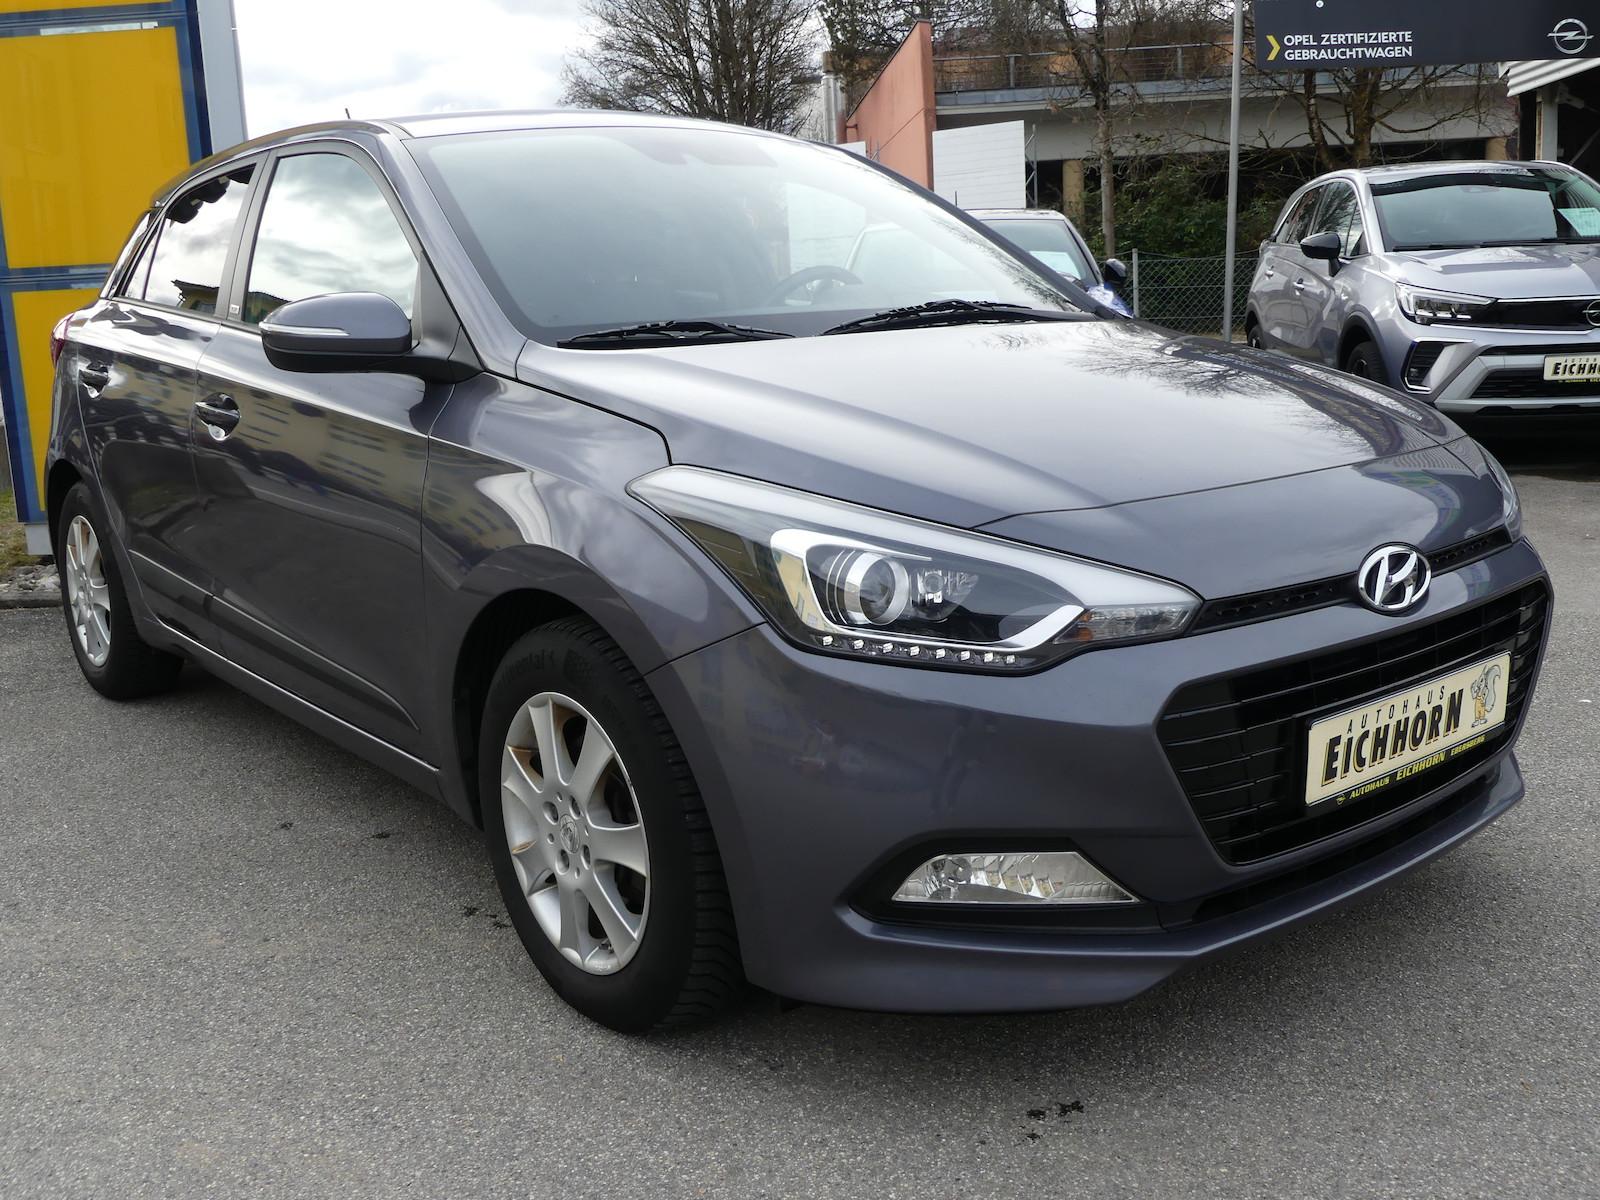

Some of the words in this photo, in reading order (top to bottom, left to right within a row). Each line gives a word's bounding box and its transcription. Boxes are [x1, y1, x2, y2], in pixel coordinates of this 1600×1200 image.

[1284, 35, 1317, 47] OPEL
[1320, 31, 1413, 45] ZERTIFIZIERTE
[1284, 46, 1413, 61] GEBRAUCHTWAGEN
[1346, 685, 1445, 734] AUTOHAUS
[1321, 688, 1464, 787] EICHHORN
[1349, 776, 1391, 799] AUTOHAUS
[1396, 751, 1446, 781] EICHHORN
